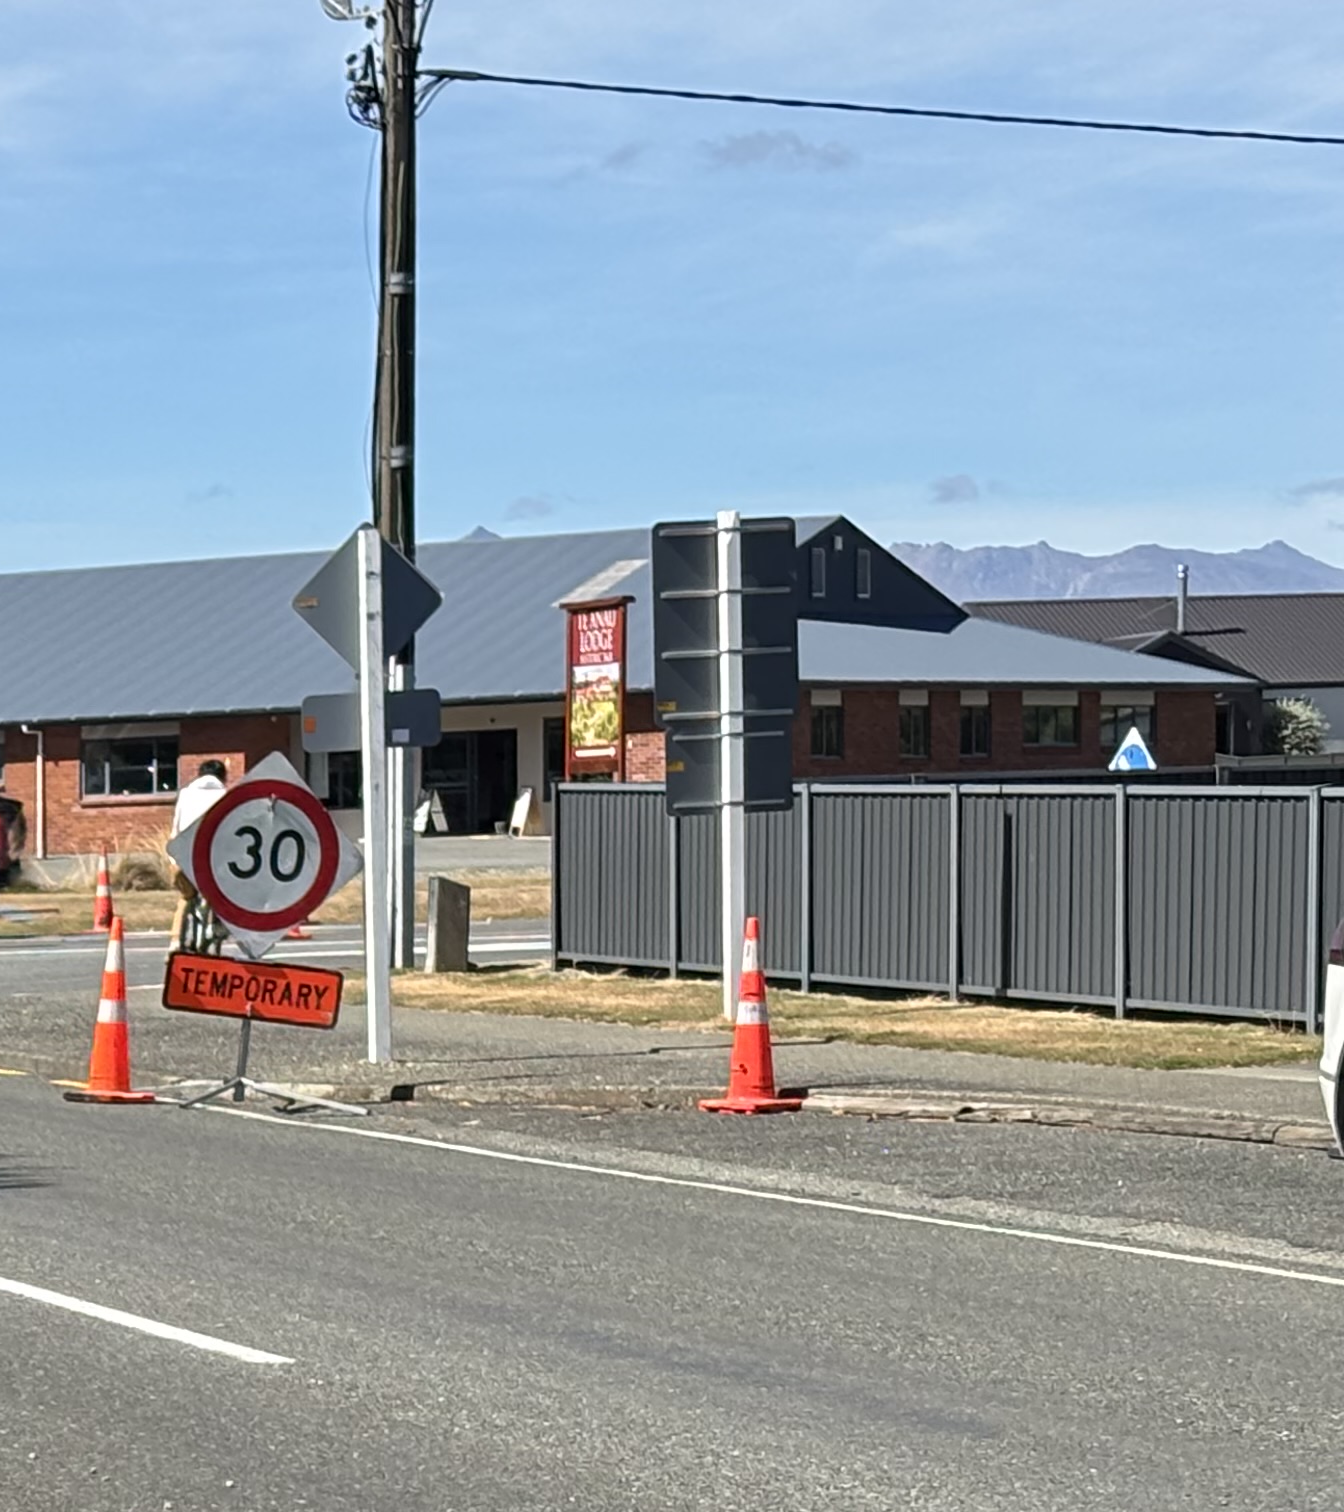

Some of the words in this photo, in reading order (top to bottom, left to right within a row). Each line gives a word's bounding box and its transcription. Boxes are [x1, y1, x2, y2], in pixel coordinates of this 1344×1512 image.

[579, 628, 614, 653] LODGE
[228, 825, 306, 882] 30
[180, 967, 330, 1012] TEMPORARY
